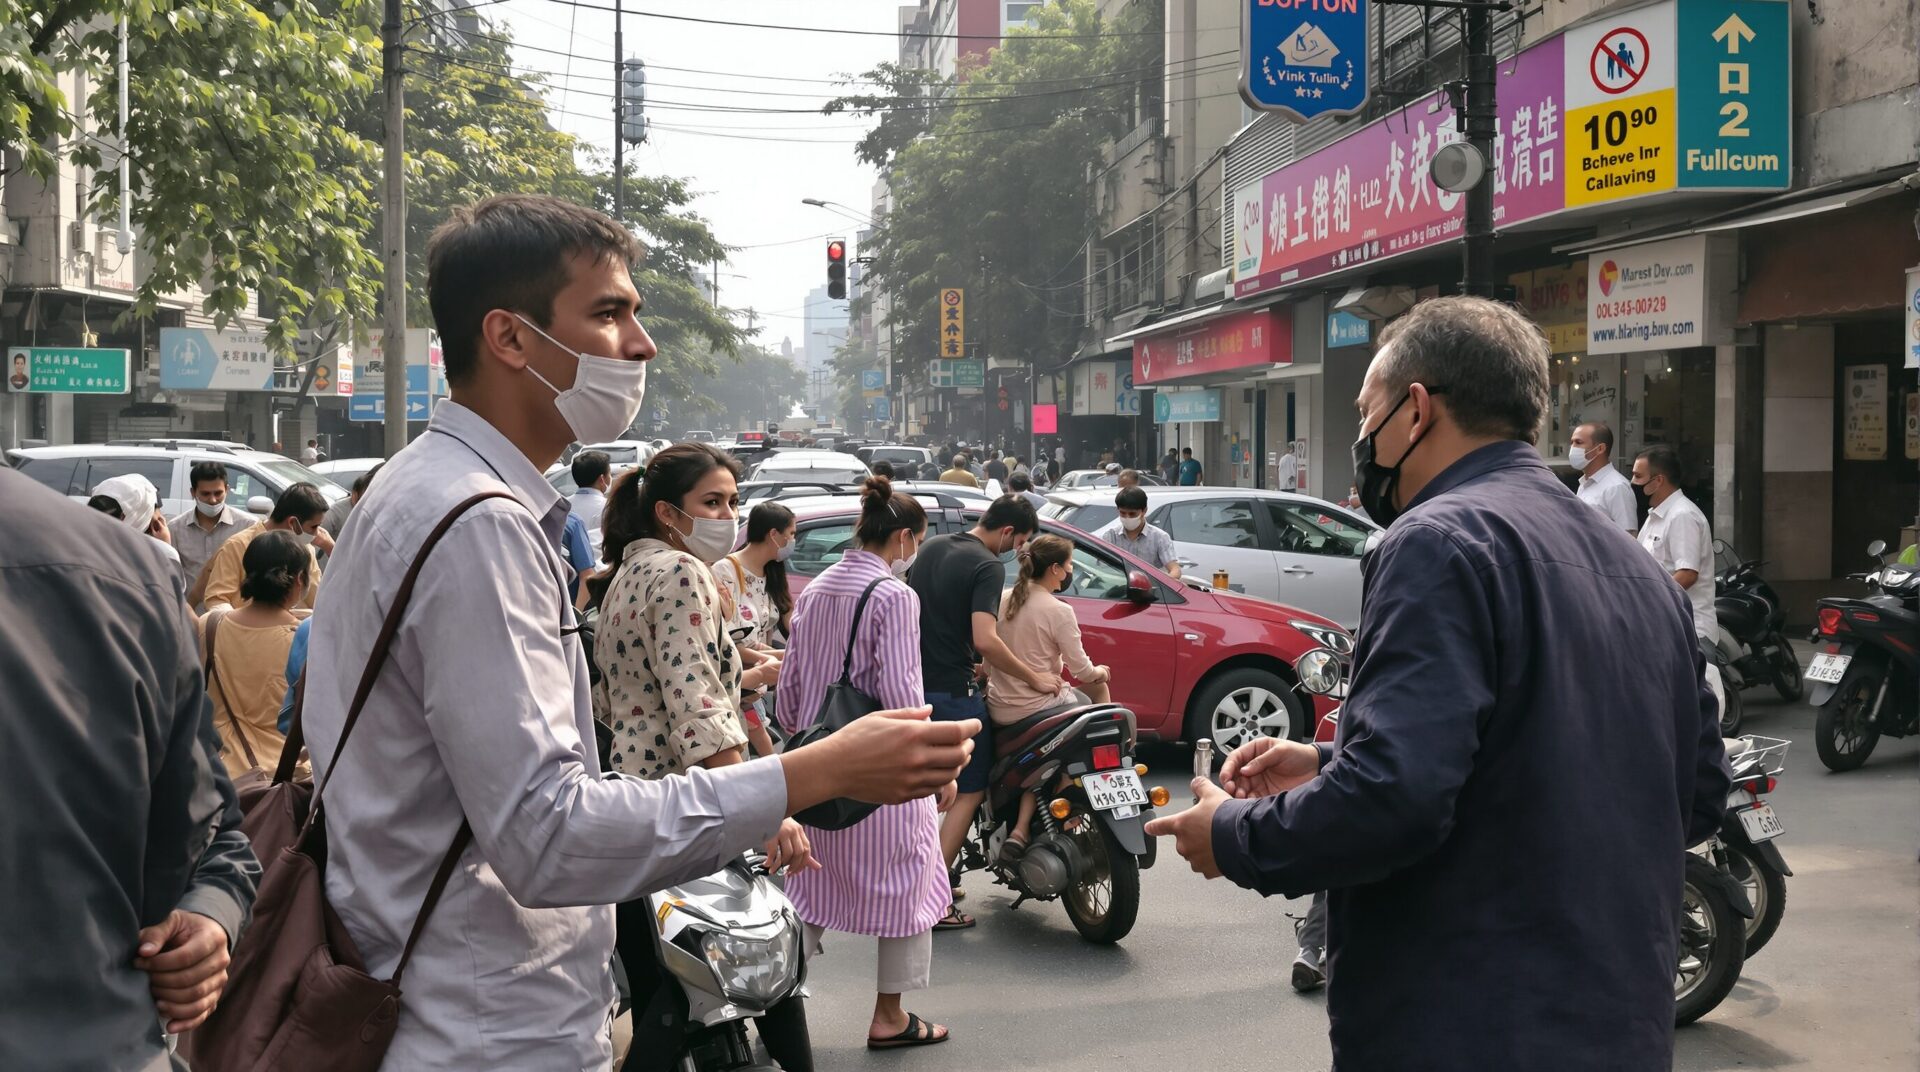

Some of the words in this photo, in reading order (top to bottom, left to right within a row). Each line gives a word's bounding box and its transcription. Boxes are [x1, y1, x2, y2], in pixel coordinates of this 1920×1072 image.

[1718, 101, 1750, 137] 2
[1687, 149, 1779, 171] Fullcum
[1586, 168, 1656, 191] Callaving
